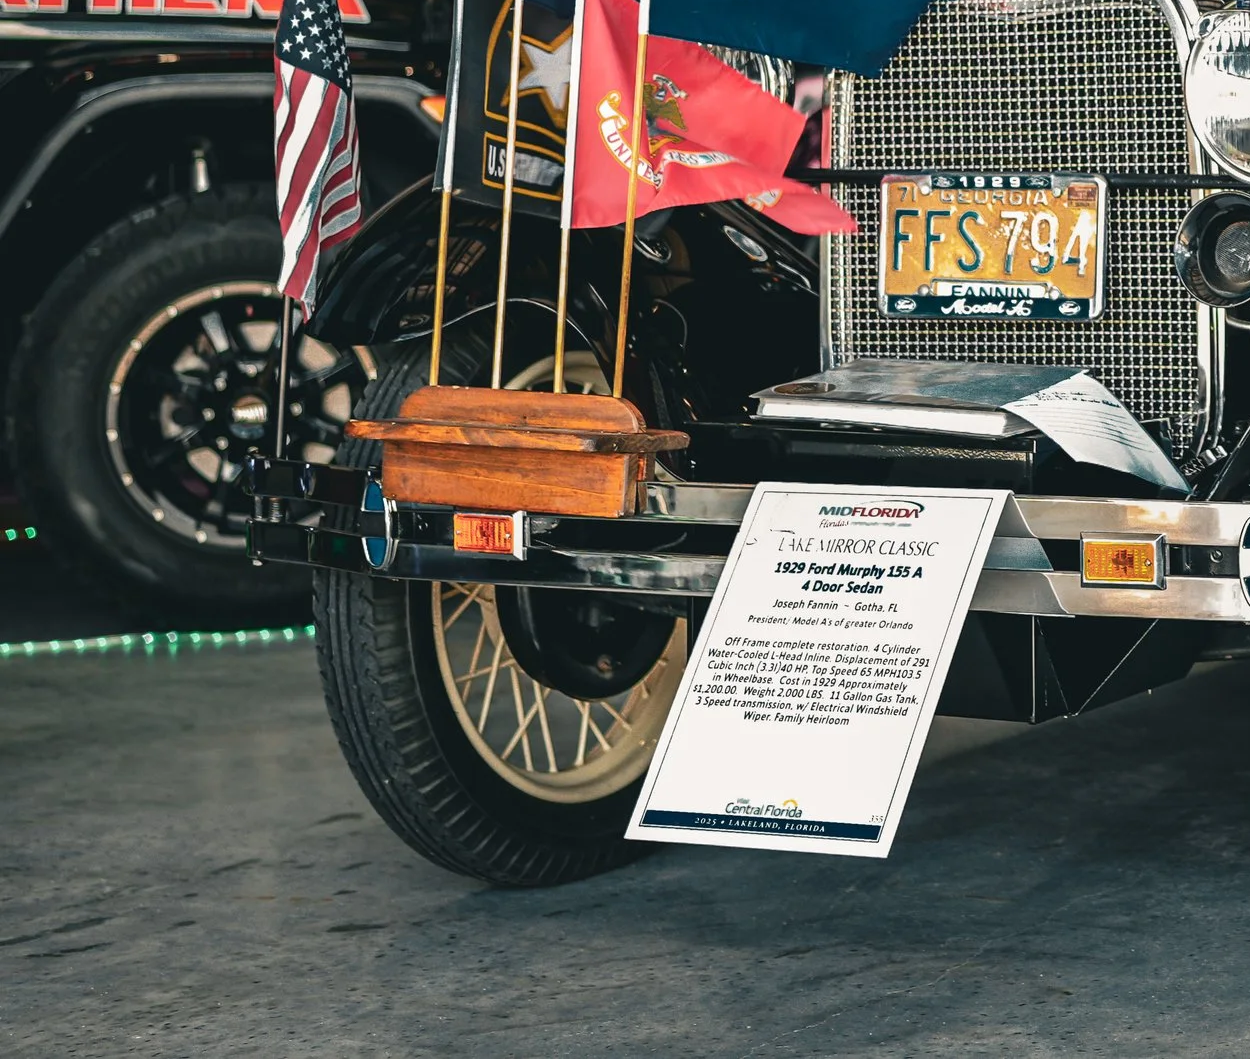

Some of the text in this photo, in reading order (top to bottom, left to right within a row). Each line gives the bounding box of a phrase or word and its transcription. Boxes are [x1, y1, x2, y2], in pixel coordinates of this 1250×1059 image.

[960, 176, 1021, 188] 1929
[898, 186, 916, 202] 71
[940, 188, 1049, 206] GEORGIA
[893, 209, 1096, 276] FFS 794
[941, 298, 1005, 315] Model
[818, 506, 920, 519] MIDFLORIDA
[778, 536, 940, 557] LAKE MIRROR CLASSIC
[774, 561, 924, 580] 1929 Ford Murphy 155 A
[801, 579, 884, 594] 4 Door Sedan
[772, 599, 805, 610] Joseph
[806, 600, 839, 611] Fannin
[887, 603, 899, 613] FL
[791, 617, 820, 626] Model
[820, 618, 833, 627] A's
[834, 618, 845, 627] of
[844, 619, 877, 630] greater
[878, 620, 914, 630] Orlando
[725, 637, 742, 646] Off
[742, 638, 770, 648] Frame
[772, 640, 815, 651] complete
[873, 644, 881, 653] 4
[881, 643, 922, 655] Cylinder
[708, 648, 770, 660] Water-Cooled
[770, 651, 804, 661] L-Head
[834, 654, 899, 666] Displacement
[900, 657, 912, 666] of
[912, 658, 930, 668] 291
[707, 660, 733, 670] Cubic
[734, 662, 755, 671] Inch
[811, 665, 828, 675] Top
[829, 666, 859, 677] Speed
[859, 667, 873, 677] 65
[712, 672, 908, 693] in Wheelbase. Cost in 1929 Approximately
[743, 686, 776, 698] Weight
[829, 691, 840, 700] 11
[842, 691, 873, 702] Gallon
[875, 693, 893, 703] Gas
[694, 696, 702, 706] 3
[702, 696, 732, 708] Speed
[796, 702, 810, 712] w/
[810, 702, 855, 714] Electrical
[855, 704, 909, 717] Windshield
[773, 712, 805, 725] Family
[805, 714, 850, 725] Heirloom
[725, 802, 803, 818] Central Florida
[694, 817, 826, 833] 2025 LAKELAND, FLORIDA
